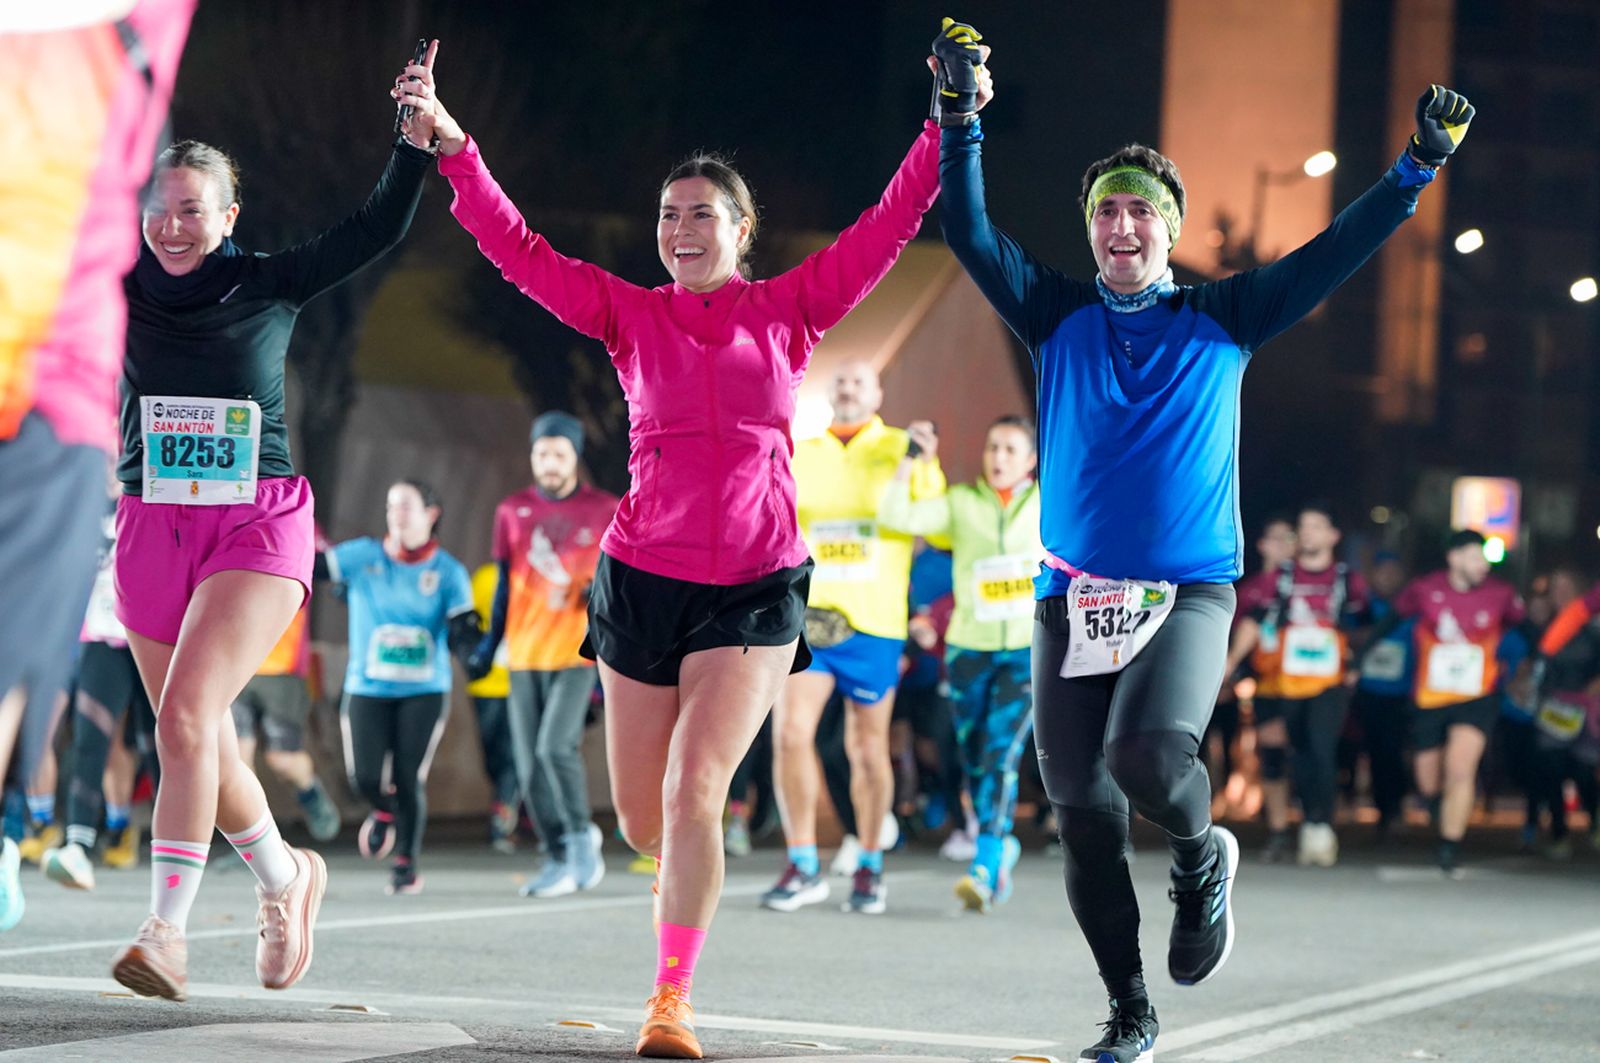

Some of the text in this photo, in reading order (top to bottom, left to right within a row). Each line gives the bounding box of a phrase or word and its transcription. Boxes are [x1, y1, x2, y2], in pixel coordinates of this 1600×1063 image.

[166, 408, 199, 420] NOCHE
[201, 410, 215, 420] DE
[153, 421, 174, 432] SAN
[176, 420, 214, 434] ANTÓN
[161, 435, 235, 469] 8253
[186, 470, 203, 478] Sara
[1077, 595, 1099, 609] SAN
